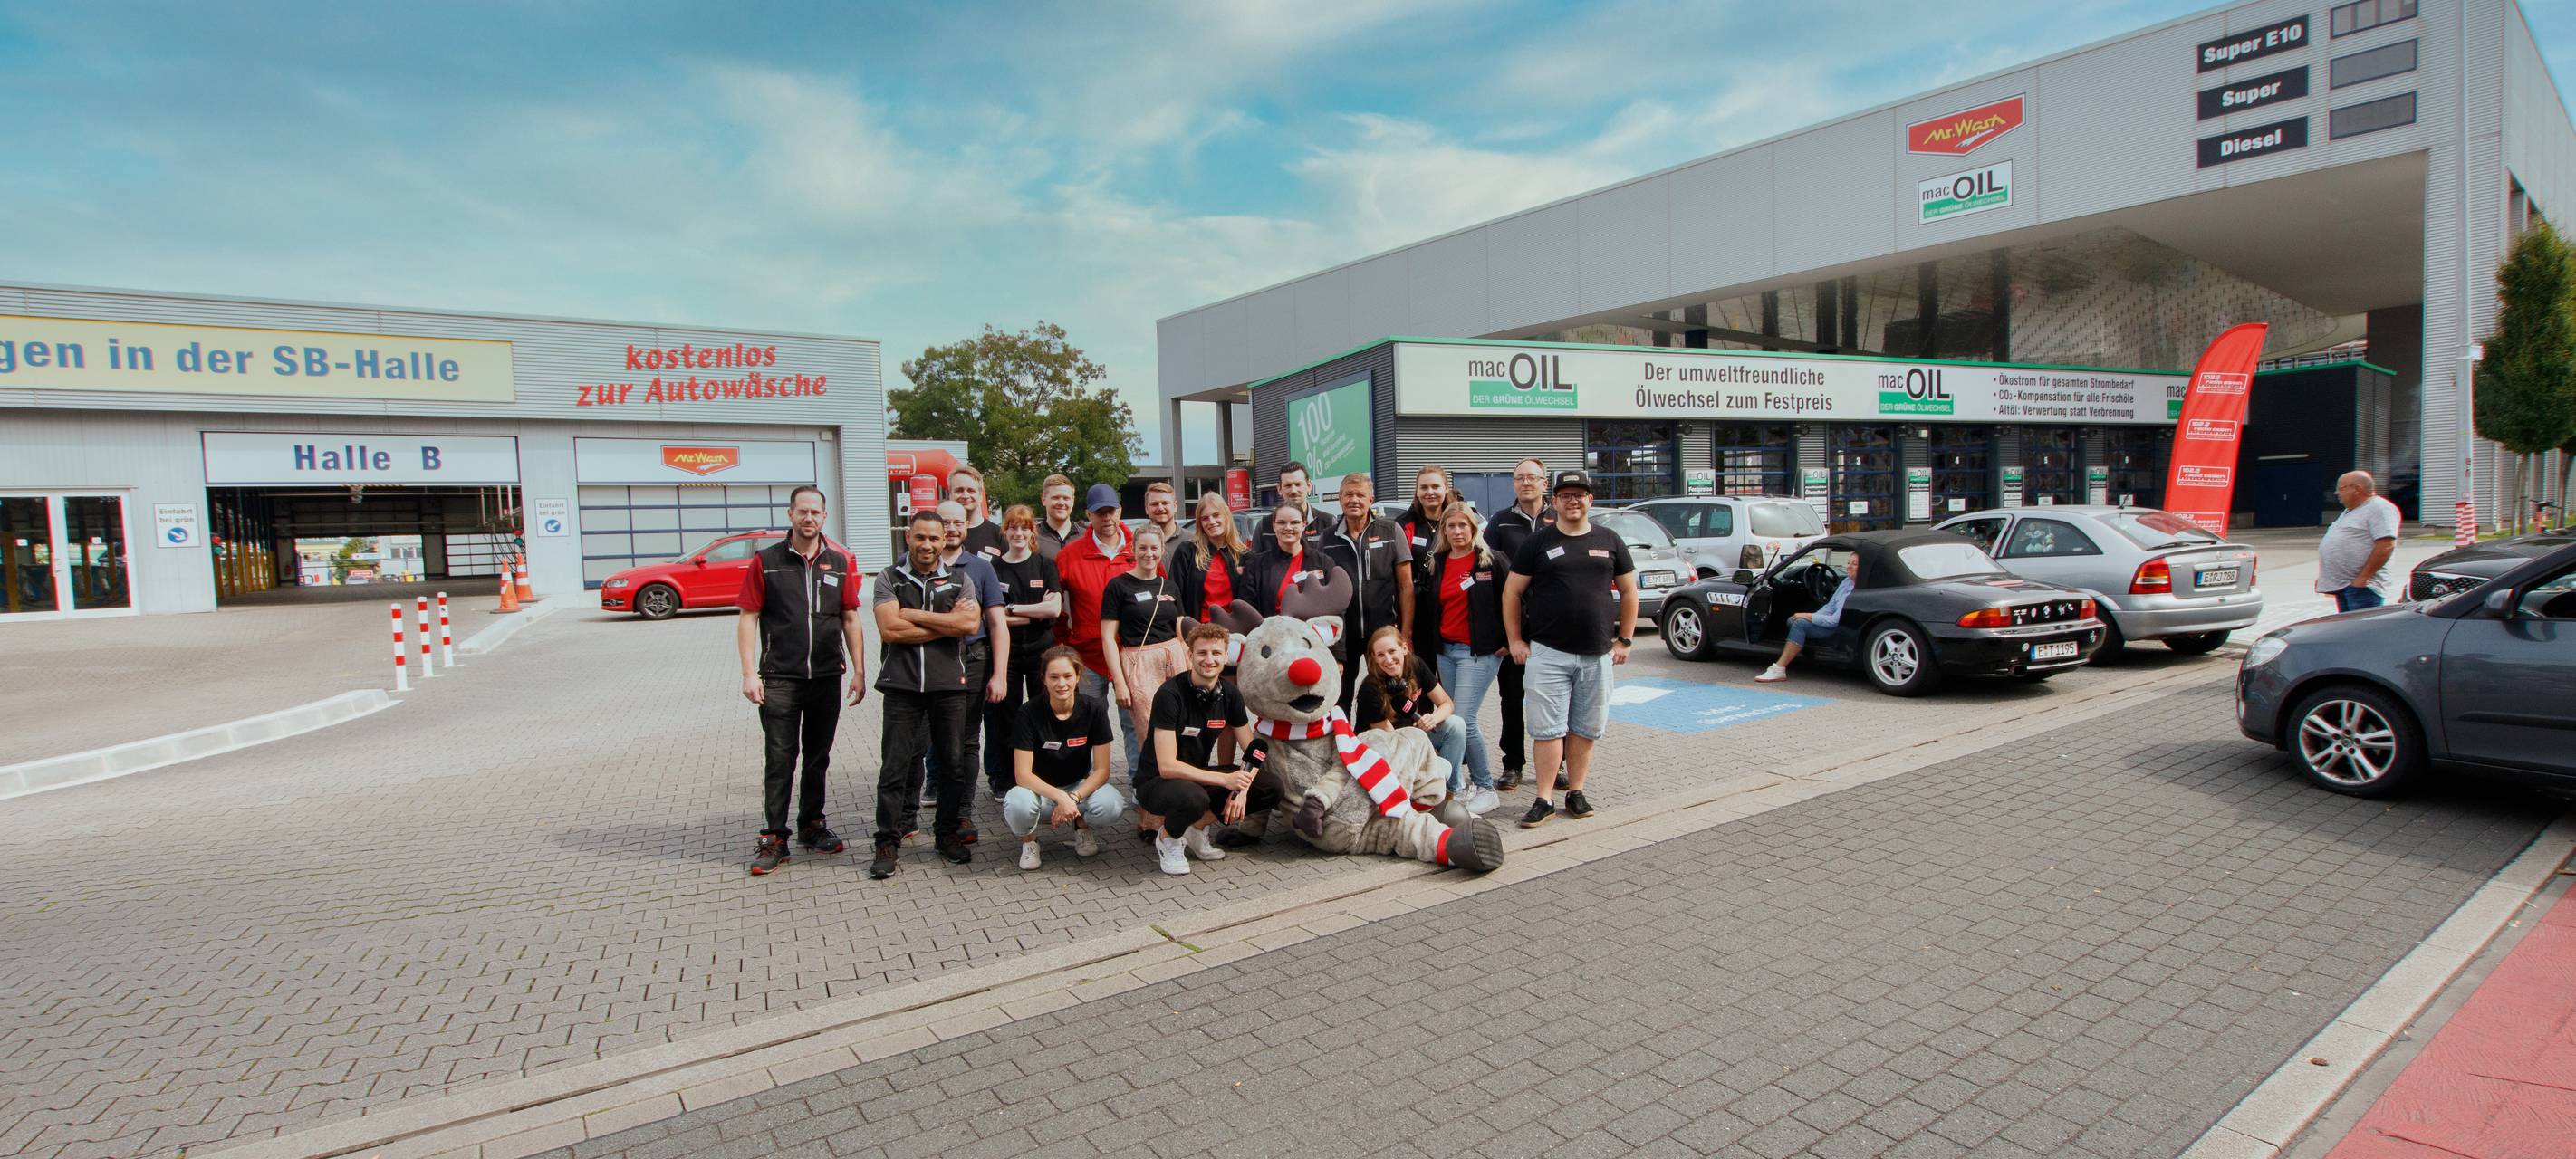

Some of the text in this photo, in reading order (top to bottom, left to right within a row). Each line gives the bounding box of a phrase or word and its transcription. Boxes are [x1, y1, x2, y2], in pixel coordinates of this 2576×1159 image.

[2203, 24, 2302, 63] Super E10
[2222, 81, 2281, 107] Super
[2221, 129, 2283, 157] Diesel
[1925, 196, 2004, 216] DER GRÜNE ÖLWECHSEL
[108, 338, 154, 370] in
[176, 341, 254, 374] der
[273, 345, 460, 381] SB-Halle
[625, 343, 776, 370] kostenlos
[1644, 362, 1825, 386] Der umweltfreundliche
[1999, 372, 2134, 390] Ökostrom für gesamten Strombedarf
[575, 372, 828, 406] zur Autowäsche
[1472, 394, 1575, 406] DER GRÜNE ÖLWECHSEL
[1636, 385, 1833, 414] Ölwechsel zum Festpreis
[2073, 391, 2085, 403] für
[2086, 393, 2100, 403] alle
[2101, 392, 2134, 404] Frischöle
[1879, 402, 1952, 413] DER GRÜNE ÖLWECHSEL
[1998, 405, 2134, 419] Altöl: Verwertung statt Verbrennung
[1298, 391, 1332, 451] 100
[293, 445, 442, 471] Halle B
[1746, 457, 1754, 466] 2
[1856, 456, 1861, 465] 3
